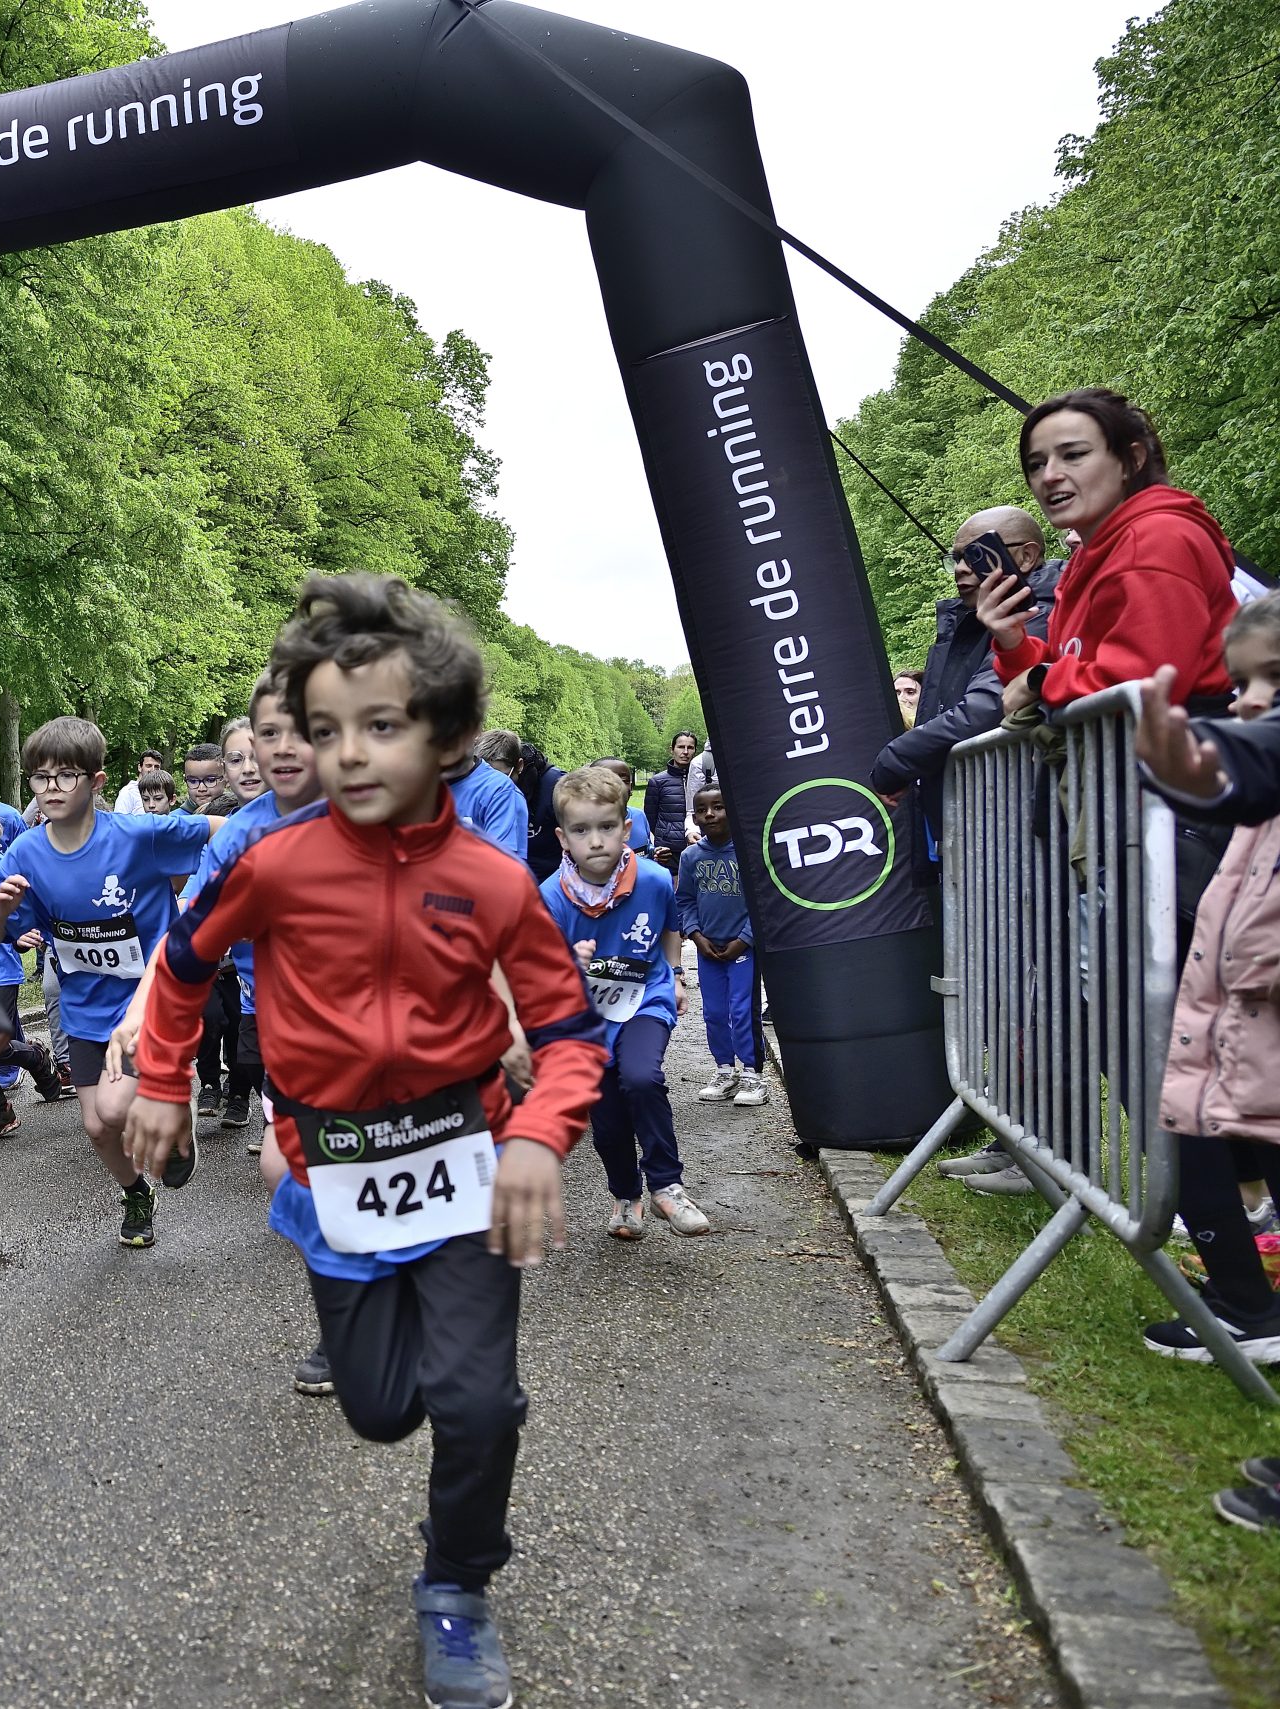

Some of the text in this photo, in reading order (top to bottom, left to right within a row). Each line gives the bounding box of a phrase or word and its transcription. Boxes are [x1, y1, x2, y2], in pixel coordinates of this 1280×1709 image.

[67, 72, 264, 151] running
[702, 353, 830, 760] terre de running
[774, 816, 883, 869] TDR
[695, 859, 740, 880] STAY
[77, 926, 101, 934] TERRE
[89, 928, 127, 939] RUNNING
[74, 948, 120, 968] 409
[325, 1132, 359, 1150] TDR
[390, 1112, 465, 1148] RUNNING
[357, 1159, 456, 1217] 424
